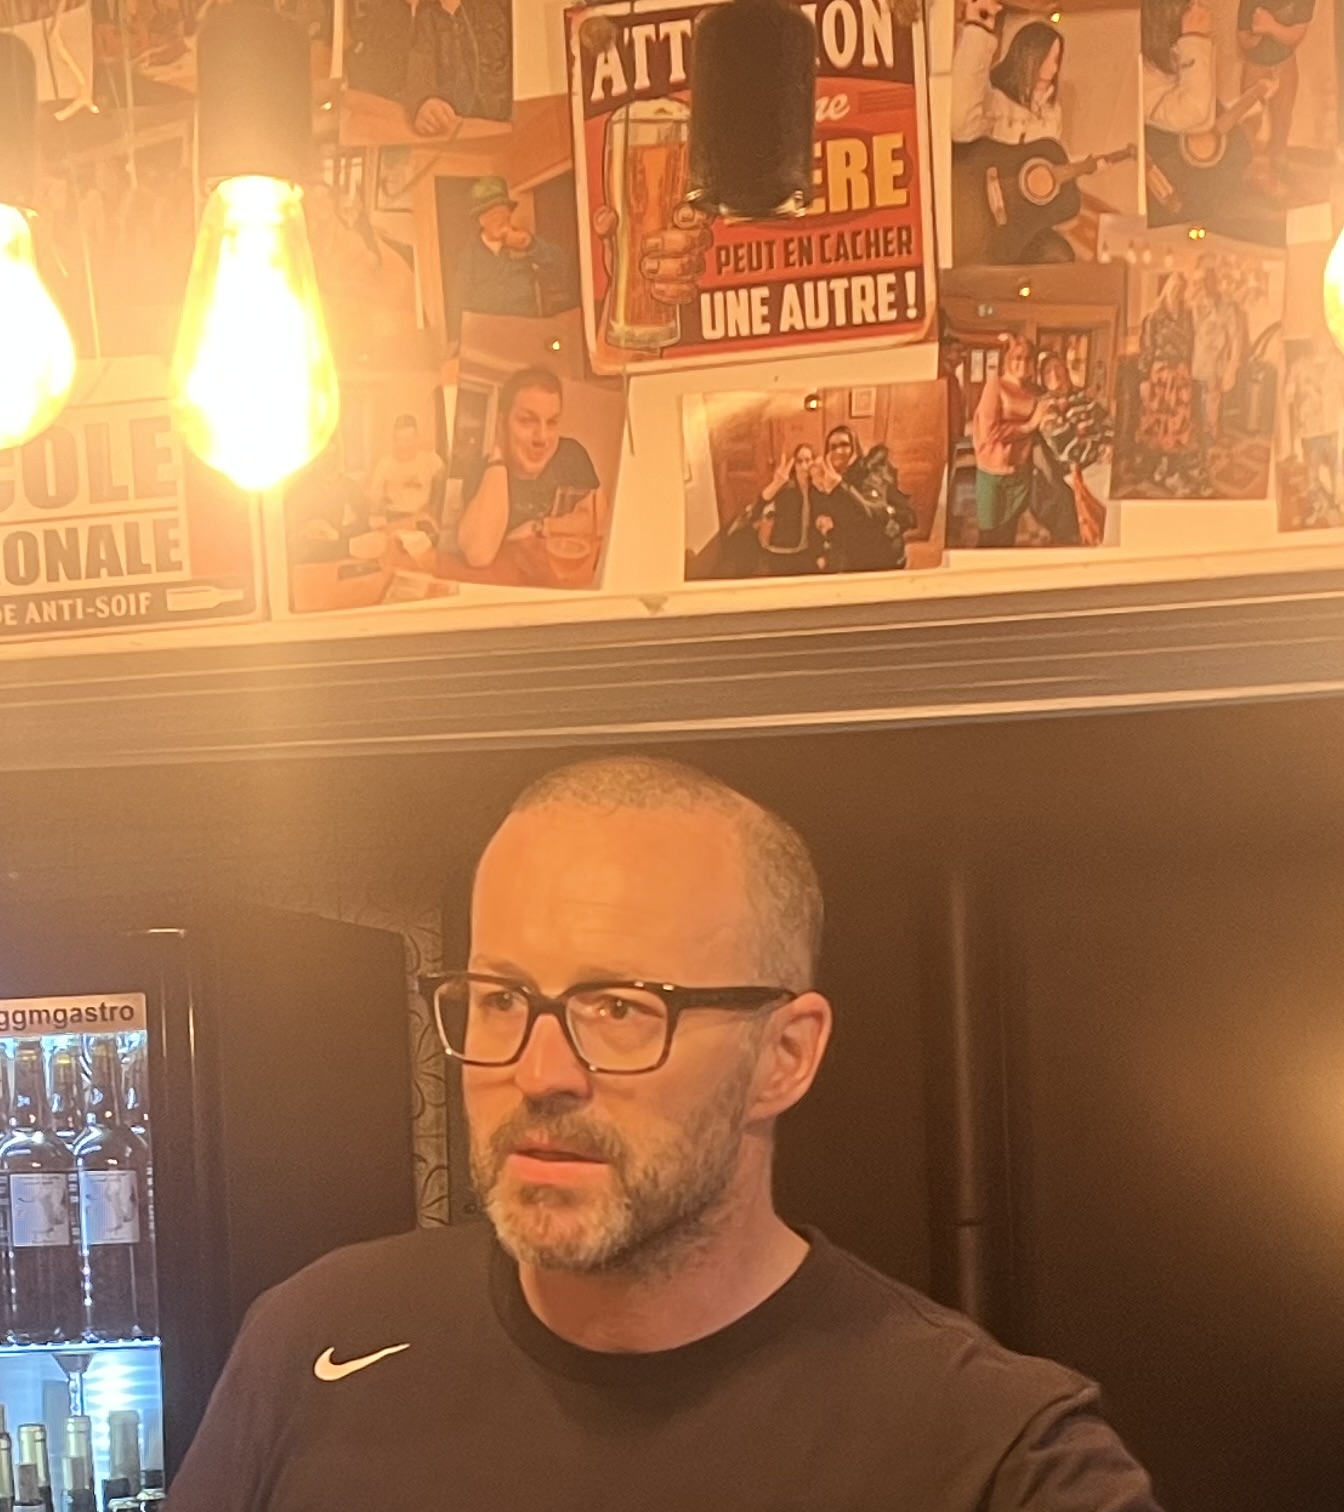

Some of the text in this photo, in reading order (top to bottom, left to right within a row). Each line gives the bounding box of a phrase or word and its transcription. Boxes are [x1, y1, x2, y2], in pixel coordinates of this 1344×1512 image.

[716, 226, 913, 275] PEUT EN CACHER
[700, 287, 771, 340] UNE
[780, 273, 898, 331] AUTRE
[24, 593, 153, 625] ANTI-SOIF
